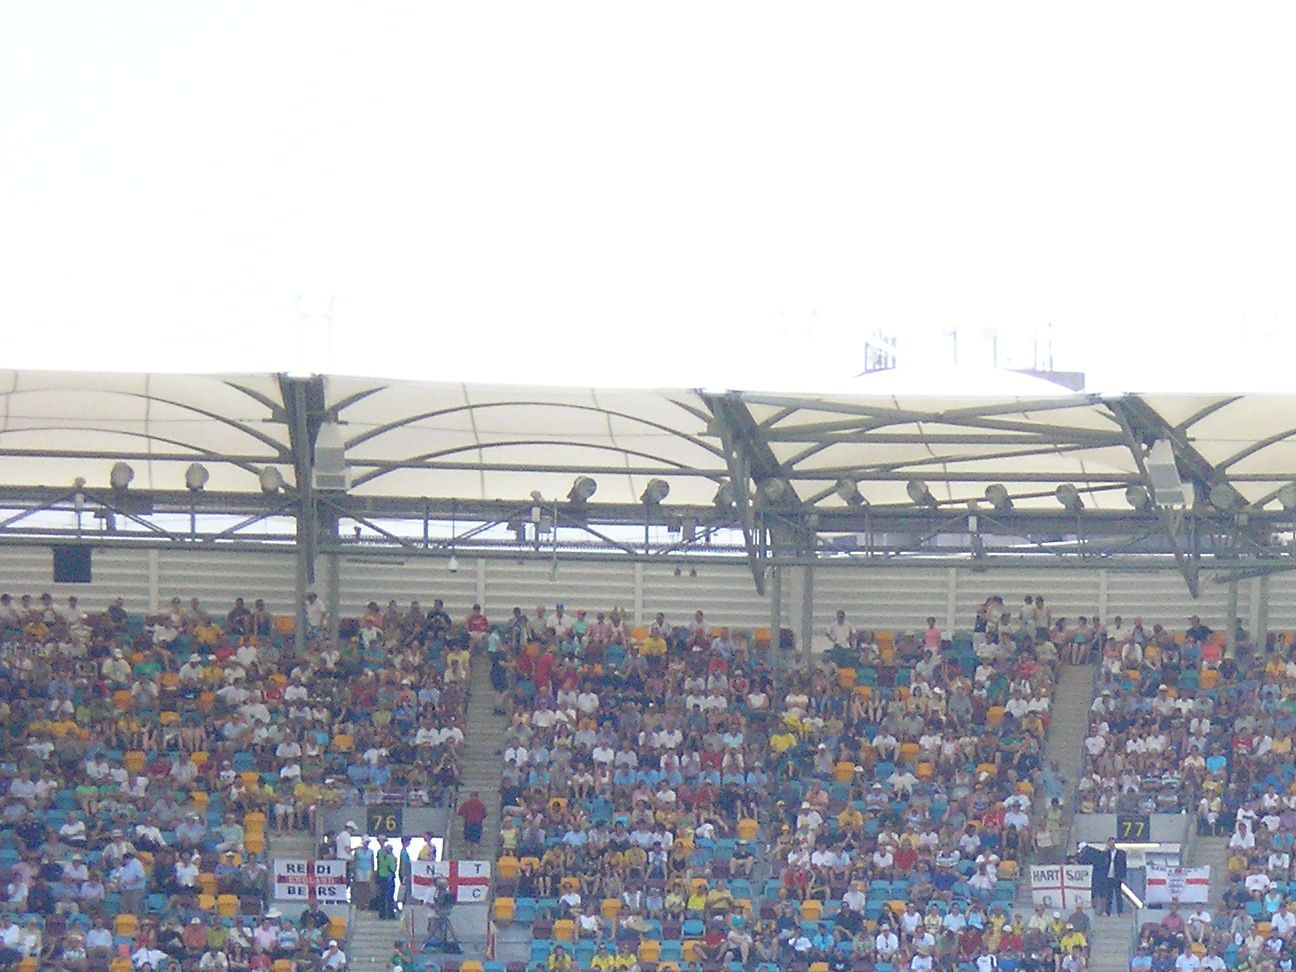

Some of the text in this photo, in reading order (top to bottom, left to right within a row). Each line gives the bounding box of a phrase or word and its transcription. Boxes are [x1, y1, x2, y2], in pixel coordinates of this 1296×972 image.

[373, 815, 396, 832] 76
[1122, 821, 1144, 837] 77
[474, 863, 481, 874] T
